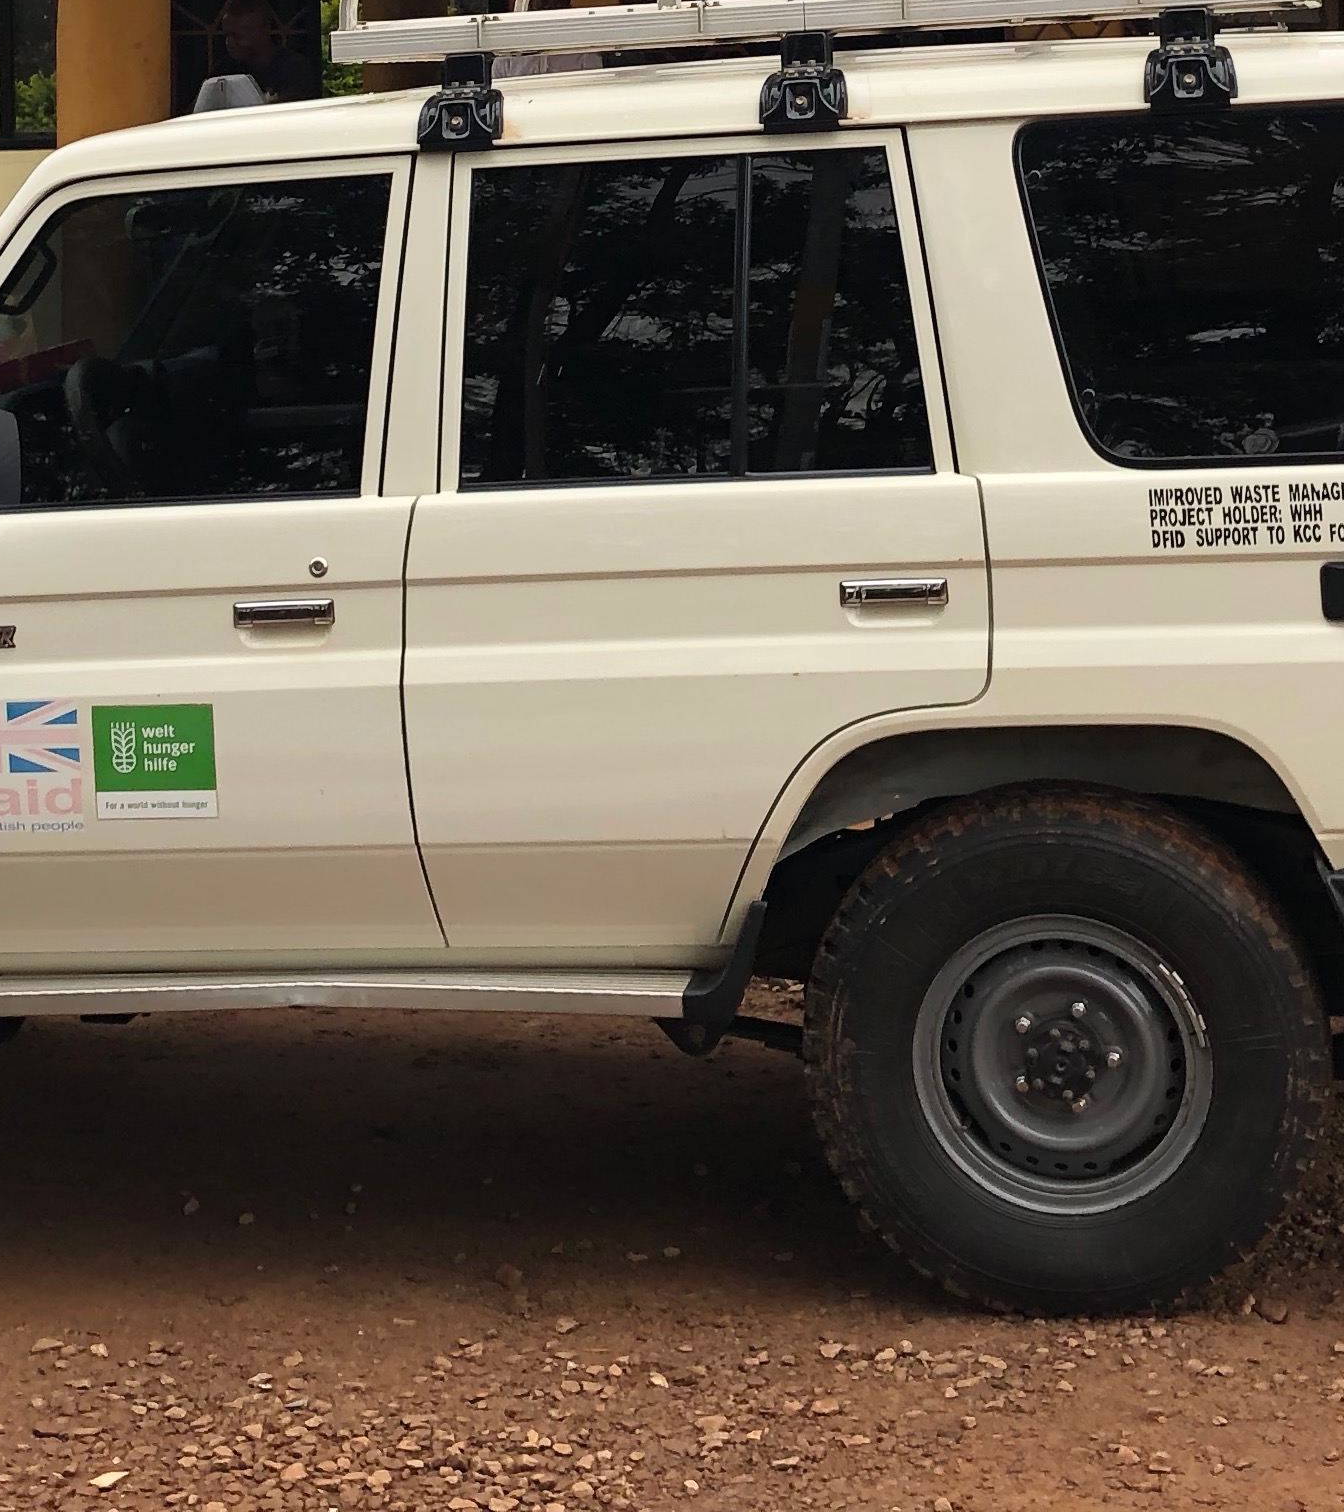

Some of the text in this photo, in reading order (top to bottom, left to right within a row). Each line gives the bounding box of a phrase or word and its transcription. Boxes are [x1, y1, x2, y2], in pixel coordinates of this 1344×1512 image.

[1148, 487, 1223, 506] IMPROVED
[1230, 484, 1281, 503] WASTE
[1150, 503, 1323, 527] PROJECT HOLDER: WHH
[1152, 529, 1186, 548] DFID
[1196, 526, 1258, 547] SUPPORT
[1267, 525, 1285, 545] TO
[1293, 524, 1322, 543] KCC
[141, 724, 175, 738] welt
[143, 741, 196, 756] hunger
[144, 758, 177, 771] hilfe
[31, 821, 84, 833] people
